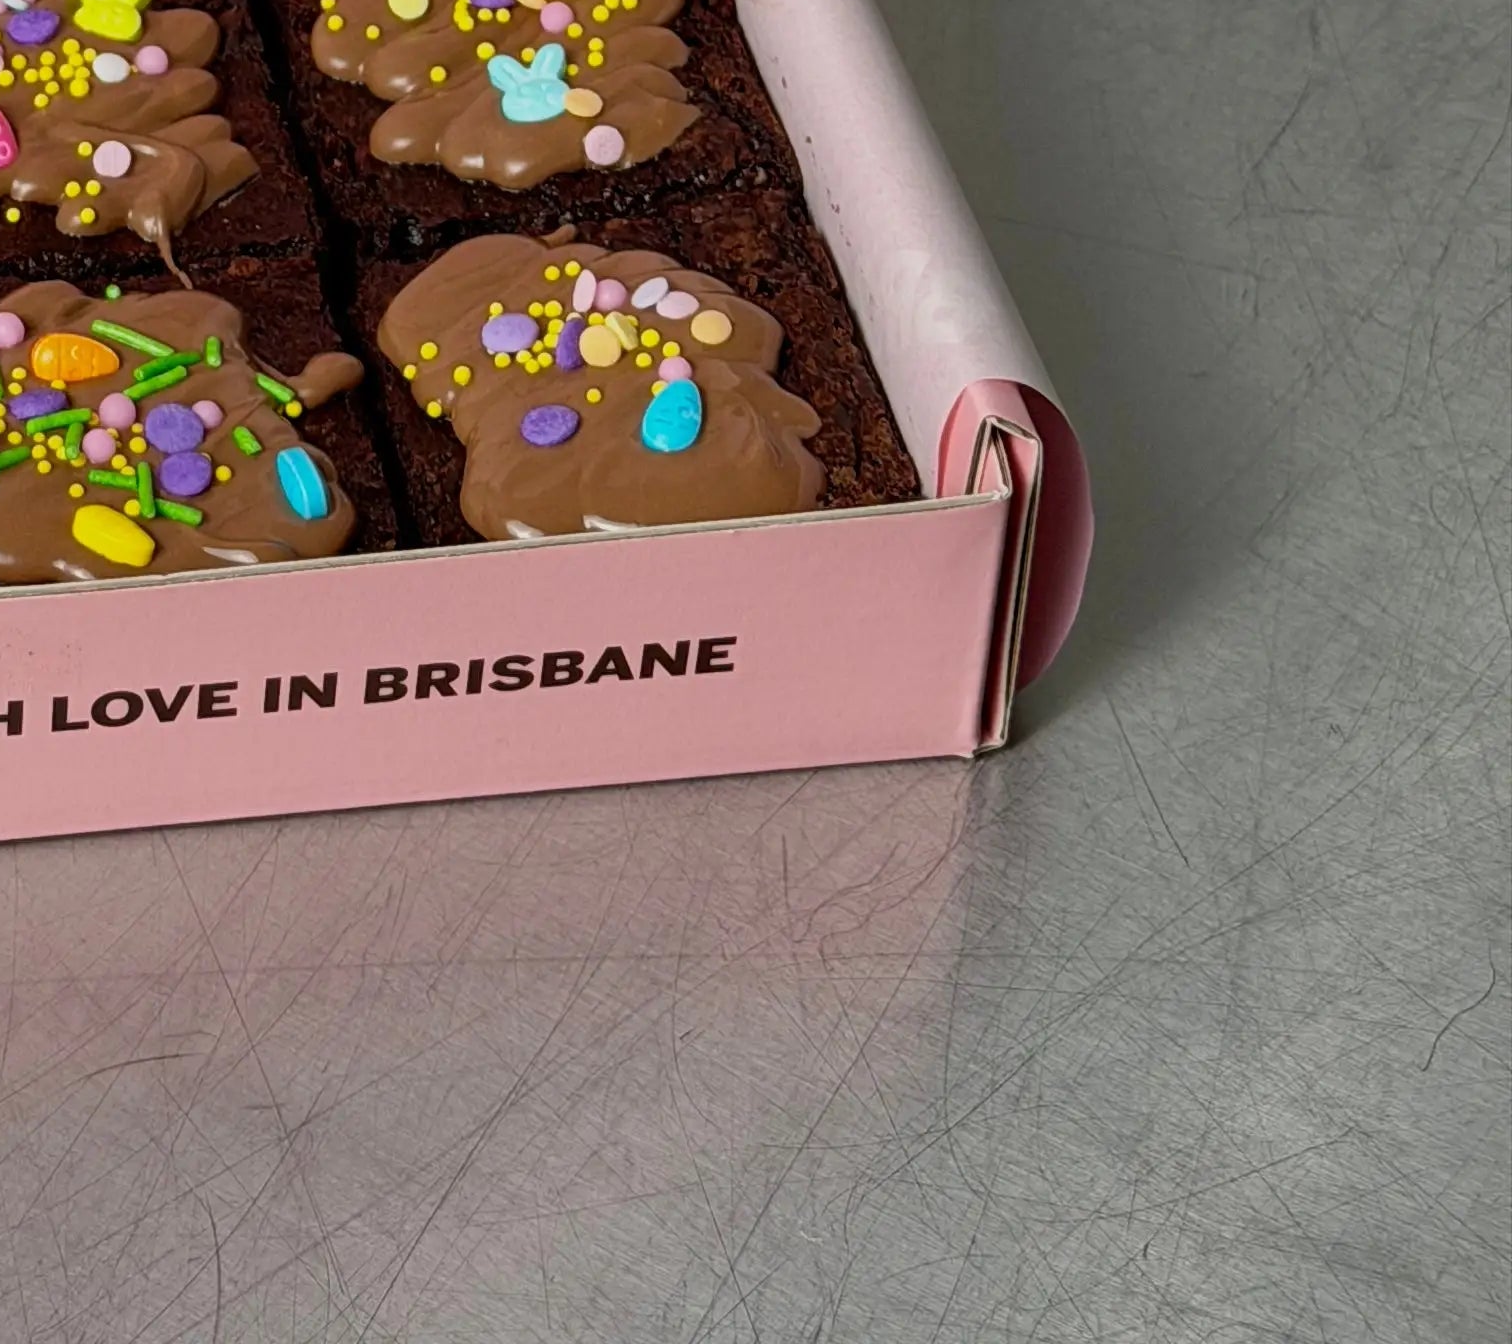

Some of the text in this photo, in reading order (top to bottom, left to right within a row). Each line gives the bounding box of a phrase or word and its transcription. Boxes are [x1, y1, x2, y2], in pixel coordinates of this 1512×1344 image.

[51, 681, 238, 733] LOVE
[263, 671, 338, 714] IN
[363, 635, 738, 705] BRISBANE
